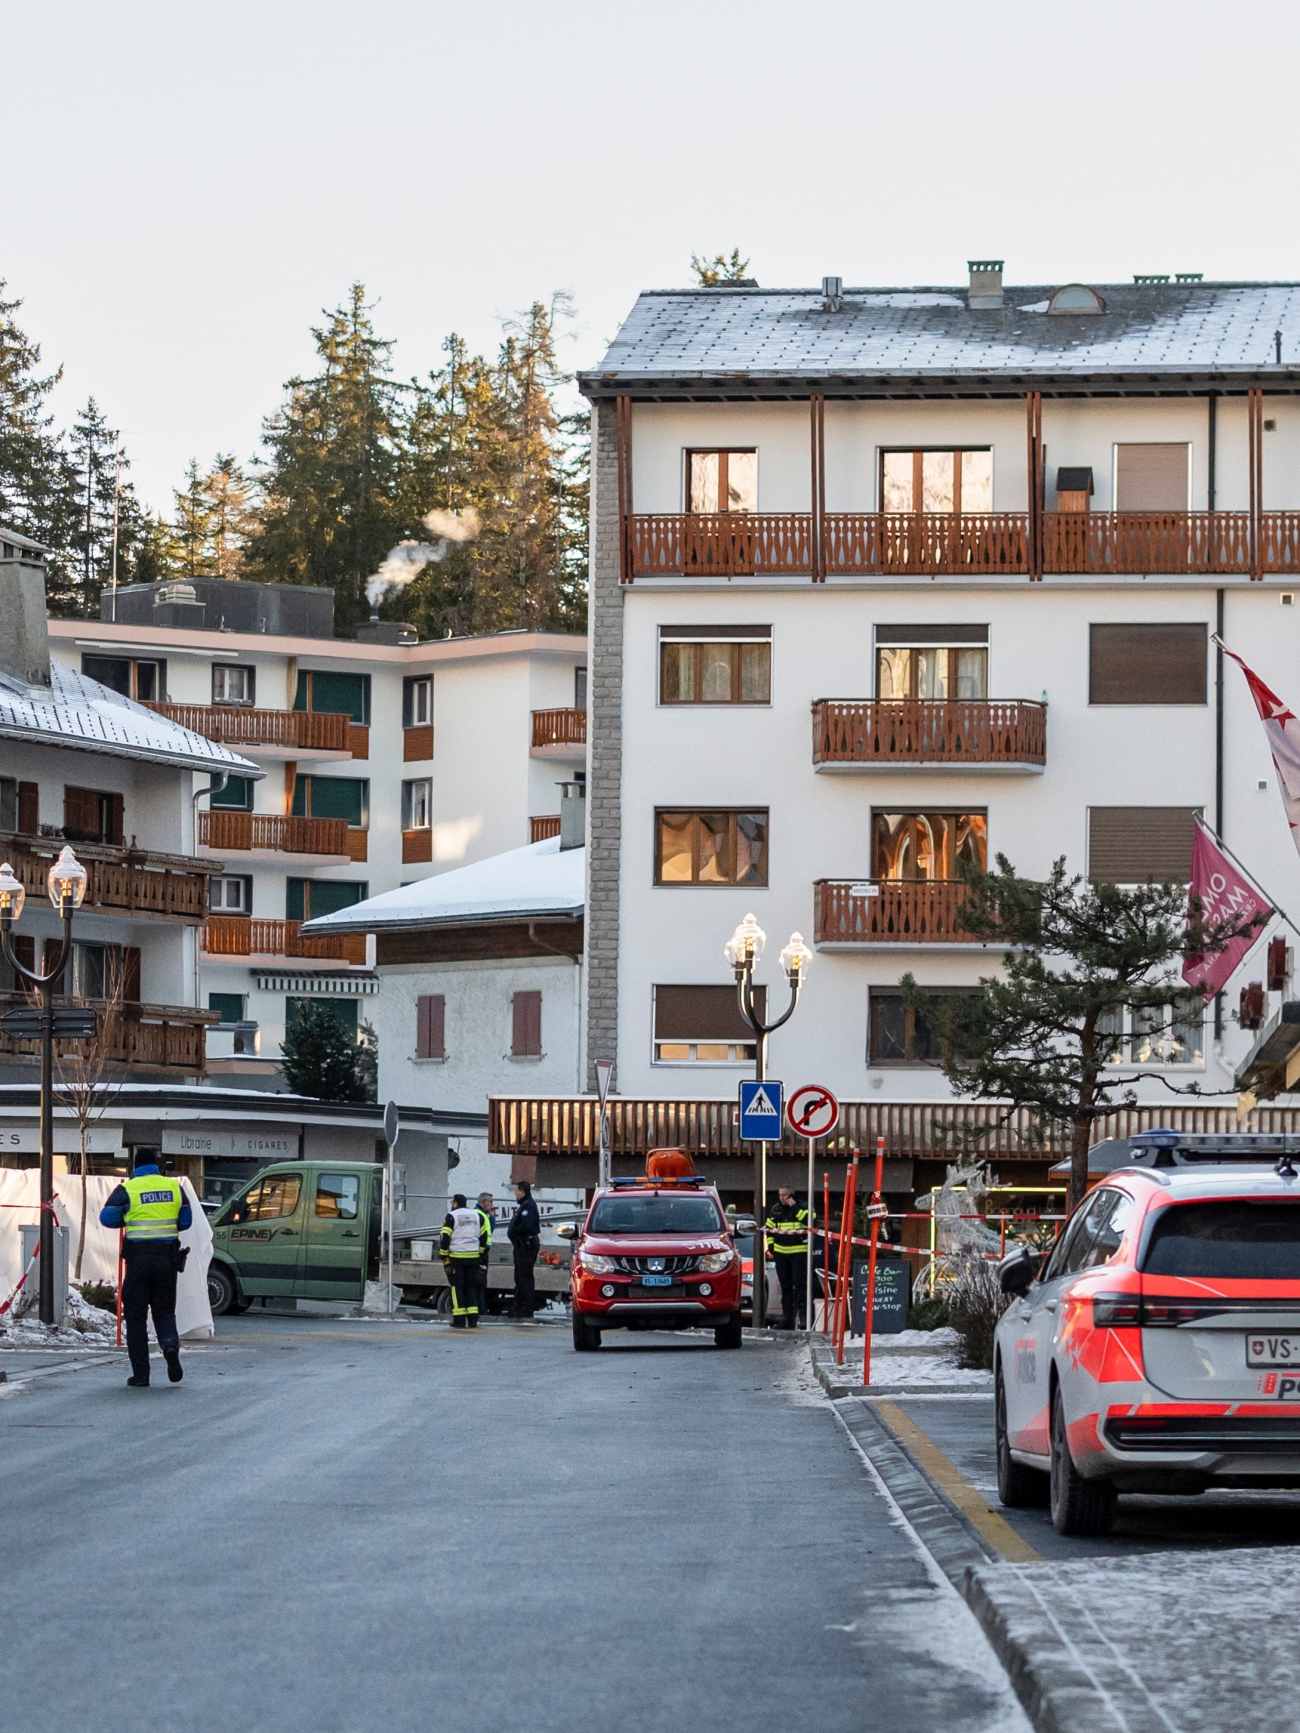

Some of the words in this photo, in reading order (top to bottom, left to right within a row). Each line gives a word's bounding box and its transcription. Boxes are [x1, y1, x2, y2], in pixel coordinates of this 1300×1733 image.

[247, 1140, 289, 1151] CIGARES
[141, 1191, 173, 1203] POLICE
[230, 1228, 278, 1242] EPINEY
[883, 1266, 903, 1276] Bar
[862, 1286, 898, 1295] Cisine
